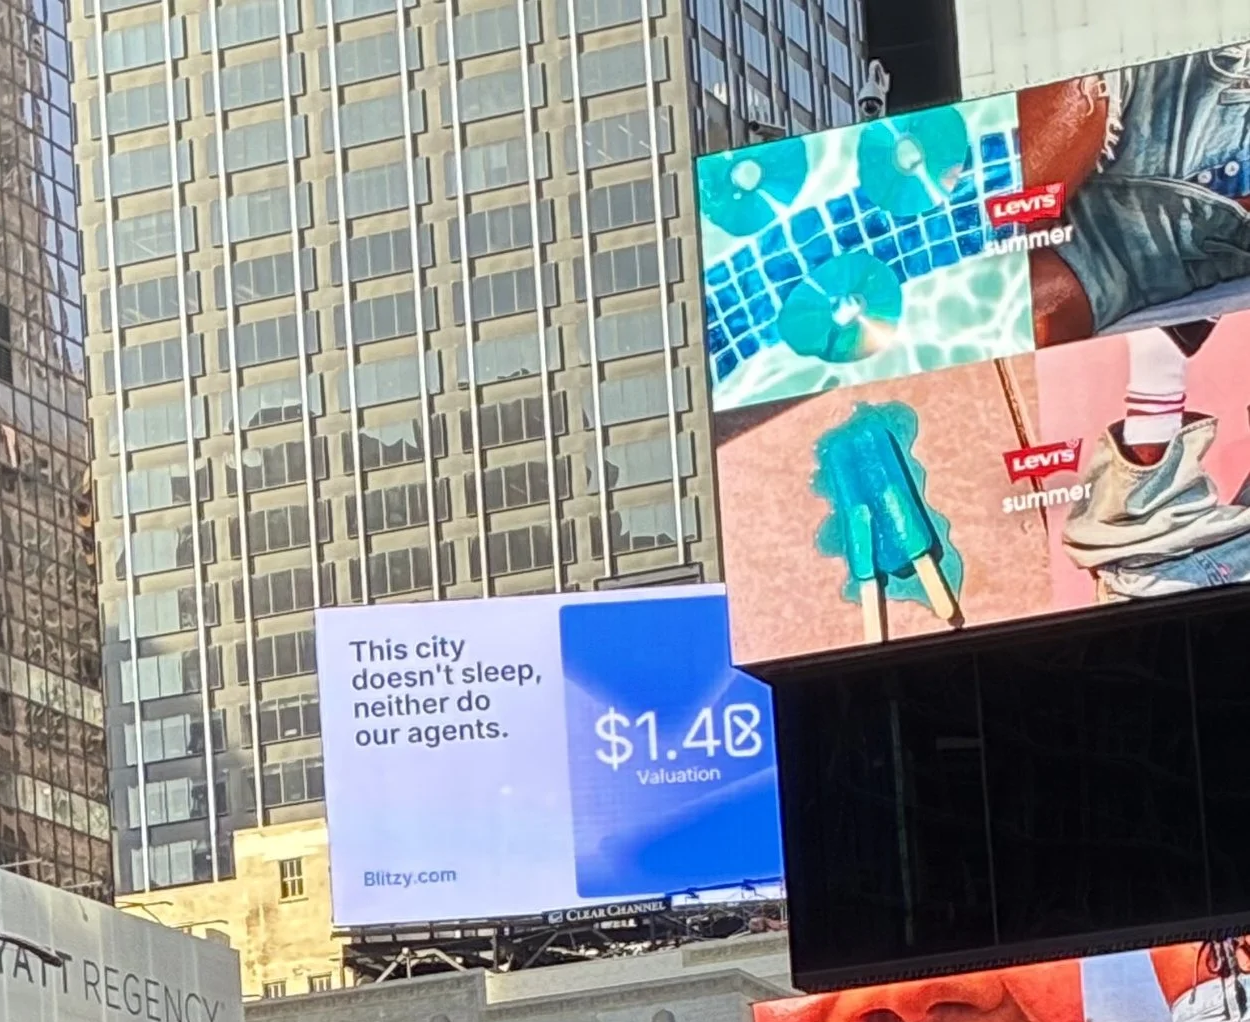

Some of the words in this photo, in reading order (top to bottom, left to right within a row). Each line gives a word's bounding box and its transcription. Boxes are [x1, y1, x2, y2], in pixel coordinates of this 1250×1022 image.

[982, 225, 1073, 258] summer
[1002, 483, 1092, 514] summer
[349, 638, 408, 662] This
[415, 635, 465, 662] city
[352, 663, 454, 690] doesn't
[461, 661, 541, 687] sleep,
[354, 693, 449, 718] neither
[456, 690, 491, 712] do
[355, 727, 400, 747] our
[408, 719, 508, 748] agents.
[636, 766, 721, 785] Valuation
[364, 869, 457, 889] Blitzy.com
[566, 907, 607, 922] CLEAR
[606, 901, 666, 917] CHANNEL
